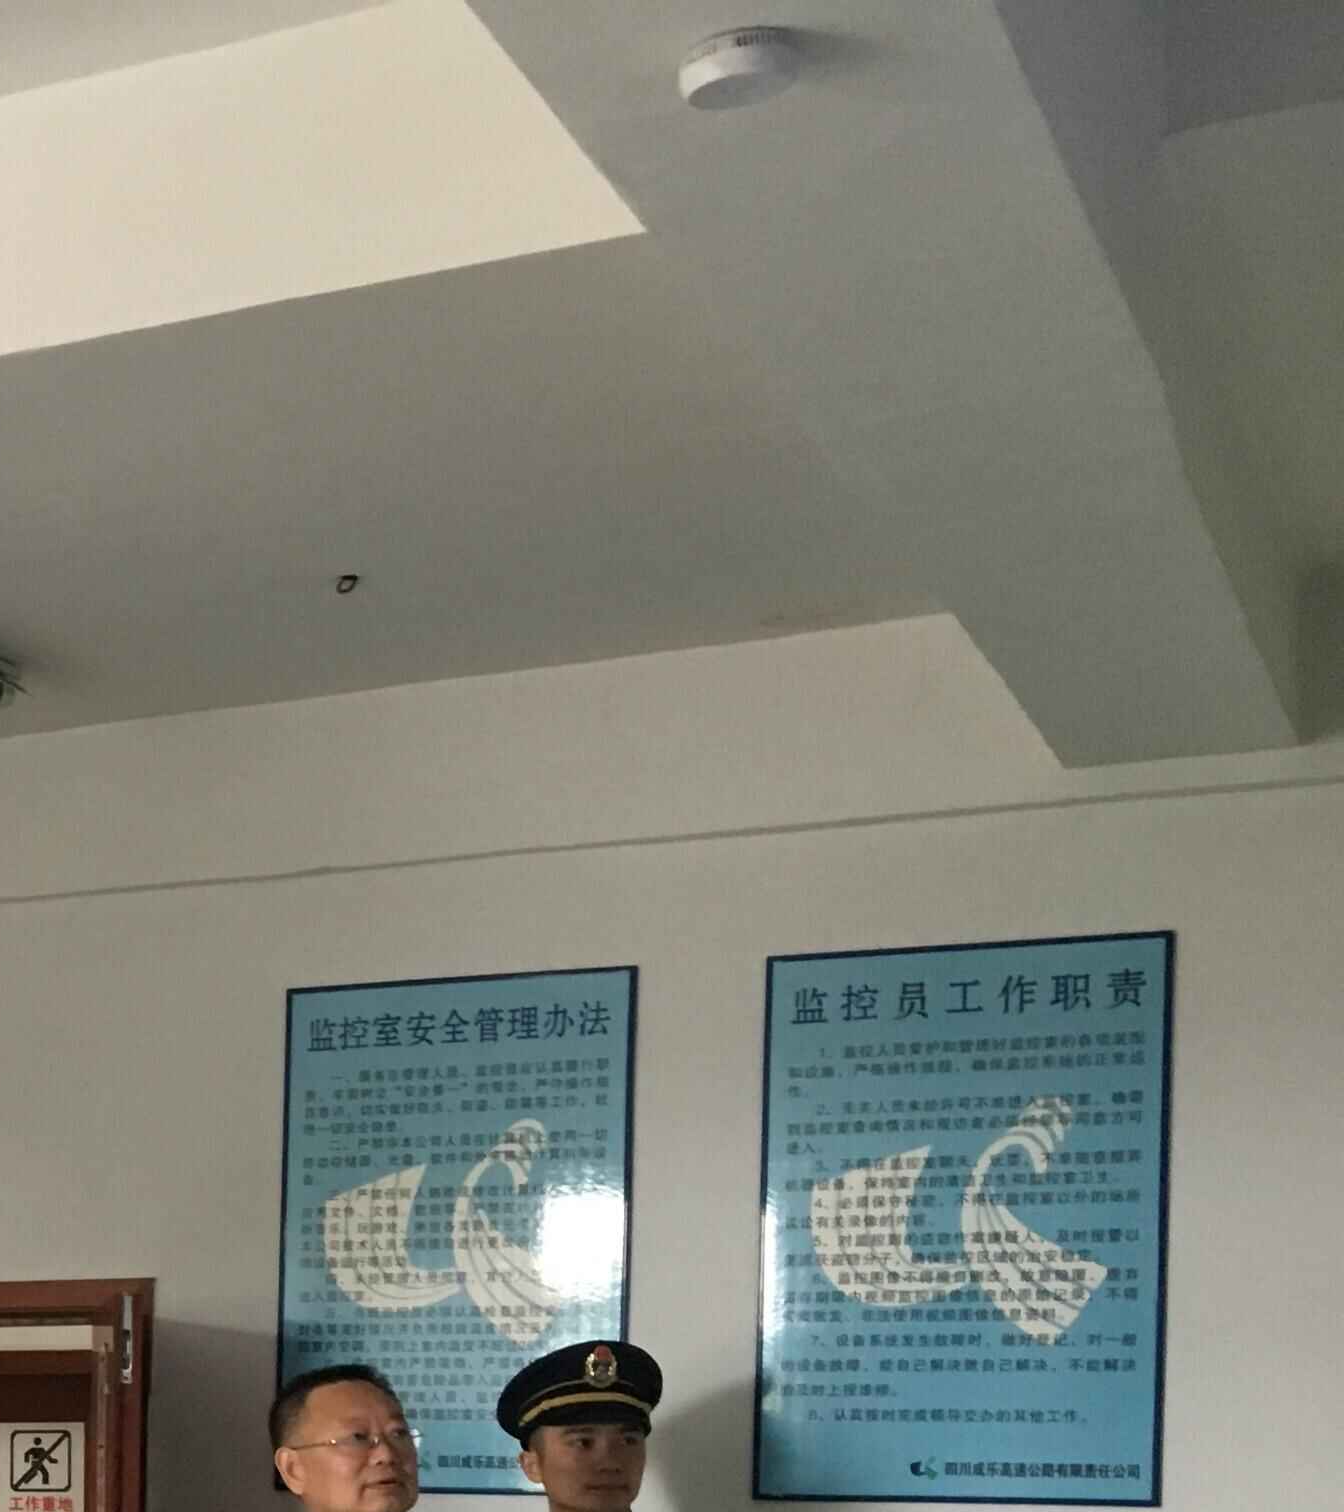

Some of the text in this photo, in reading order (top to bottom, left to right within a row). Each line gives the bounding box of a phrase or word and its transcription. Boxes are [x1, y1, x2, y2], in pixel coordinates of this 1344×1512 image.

[791, 969, 1146, 1024] 监控员工作职责
[307, 1001, 611, 1052] 监控室安全管理办法
